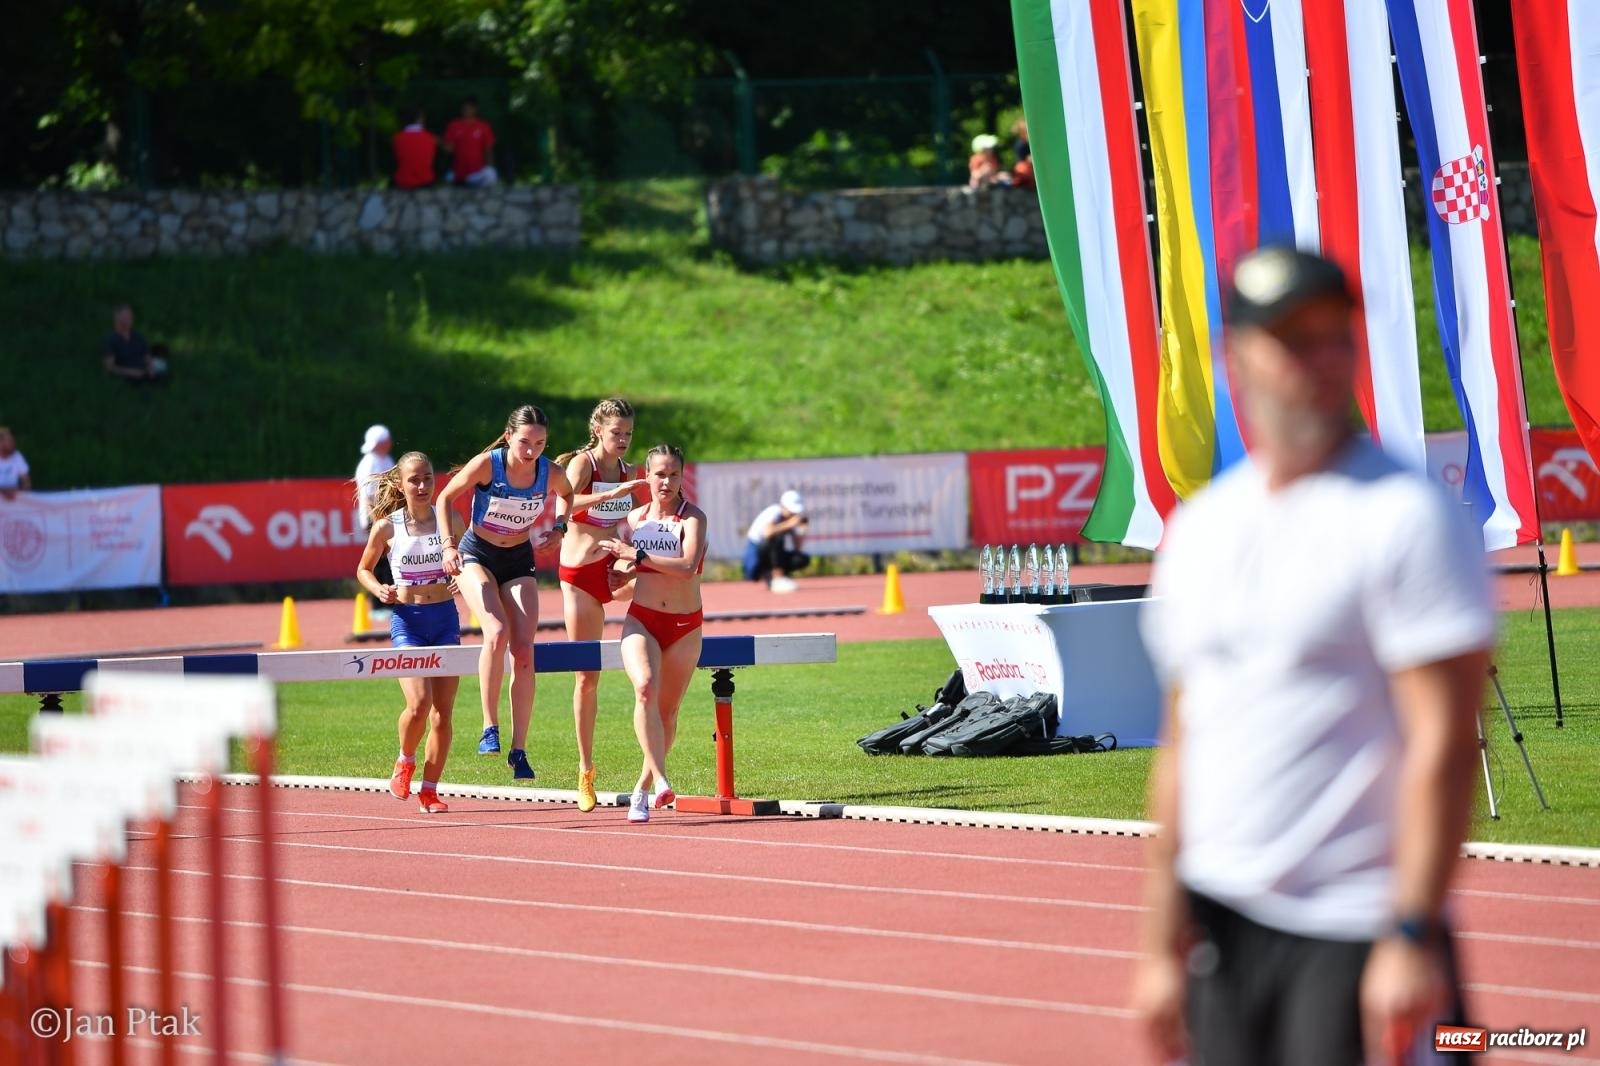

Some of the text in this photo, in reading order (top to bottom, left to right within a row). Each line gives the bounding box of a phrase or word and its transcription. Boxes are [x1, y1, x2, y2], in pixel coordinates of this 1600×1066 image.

[520, 502, 540, 511] 517
[657, 523, 677, 533] 217
[371, 653, 442, 674] polanik
